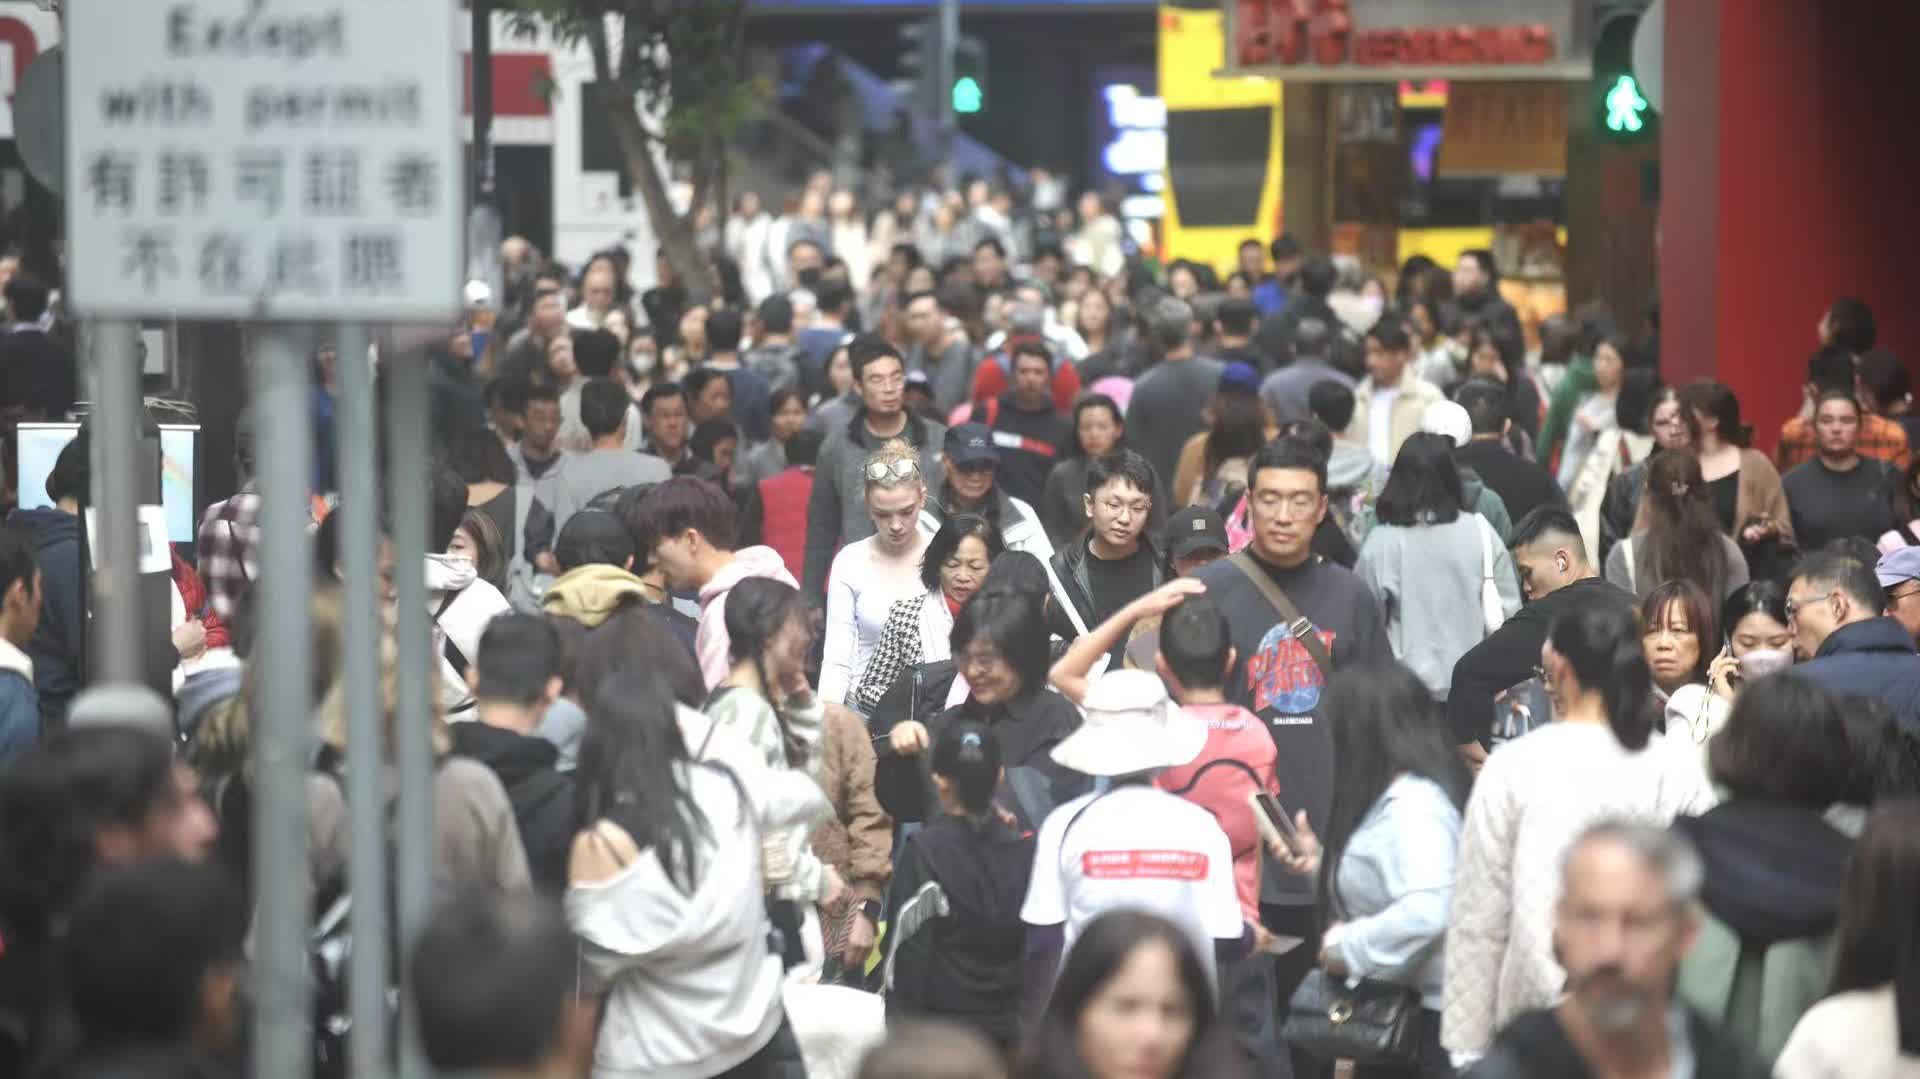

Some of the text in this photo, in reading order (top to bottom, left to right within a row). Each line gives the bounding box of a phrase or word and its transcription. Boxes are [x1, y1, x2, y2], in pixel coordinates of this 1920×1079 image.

[165, 6, 346, 62] Except
[101, 76, 421, 132] with permit
